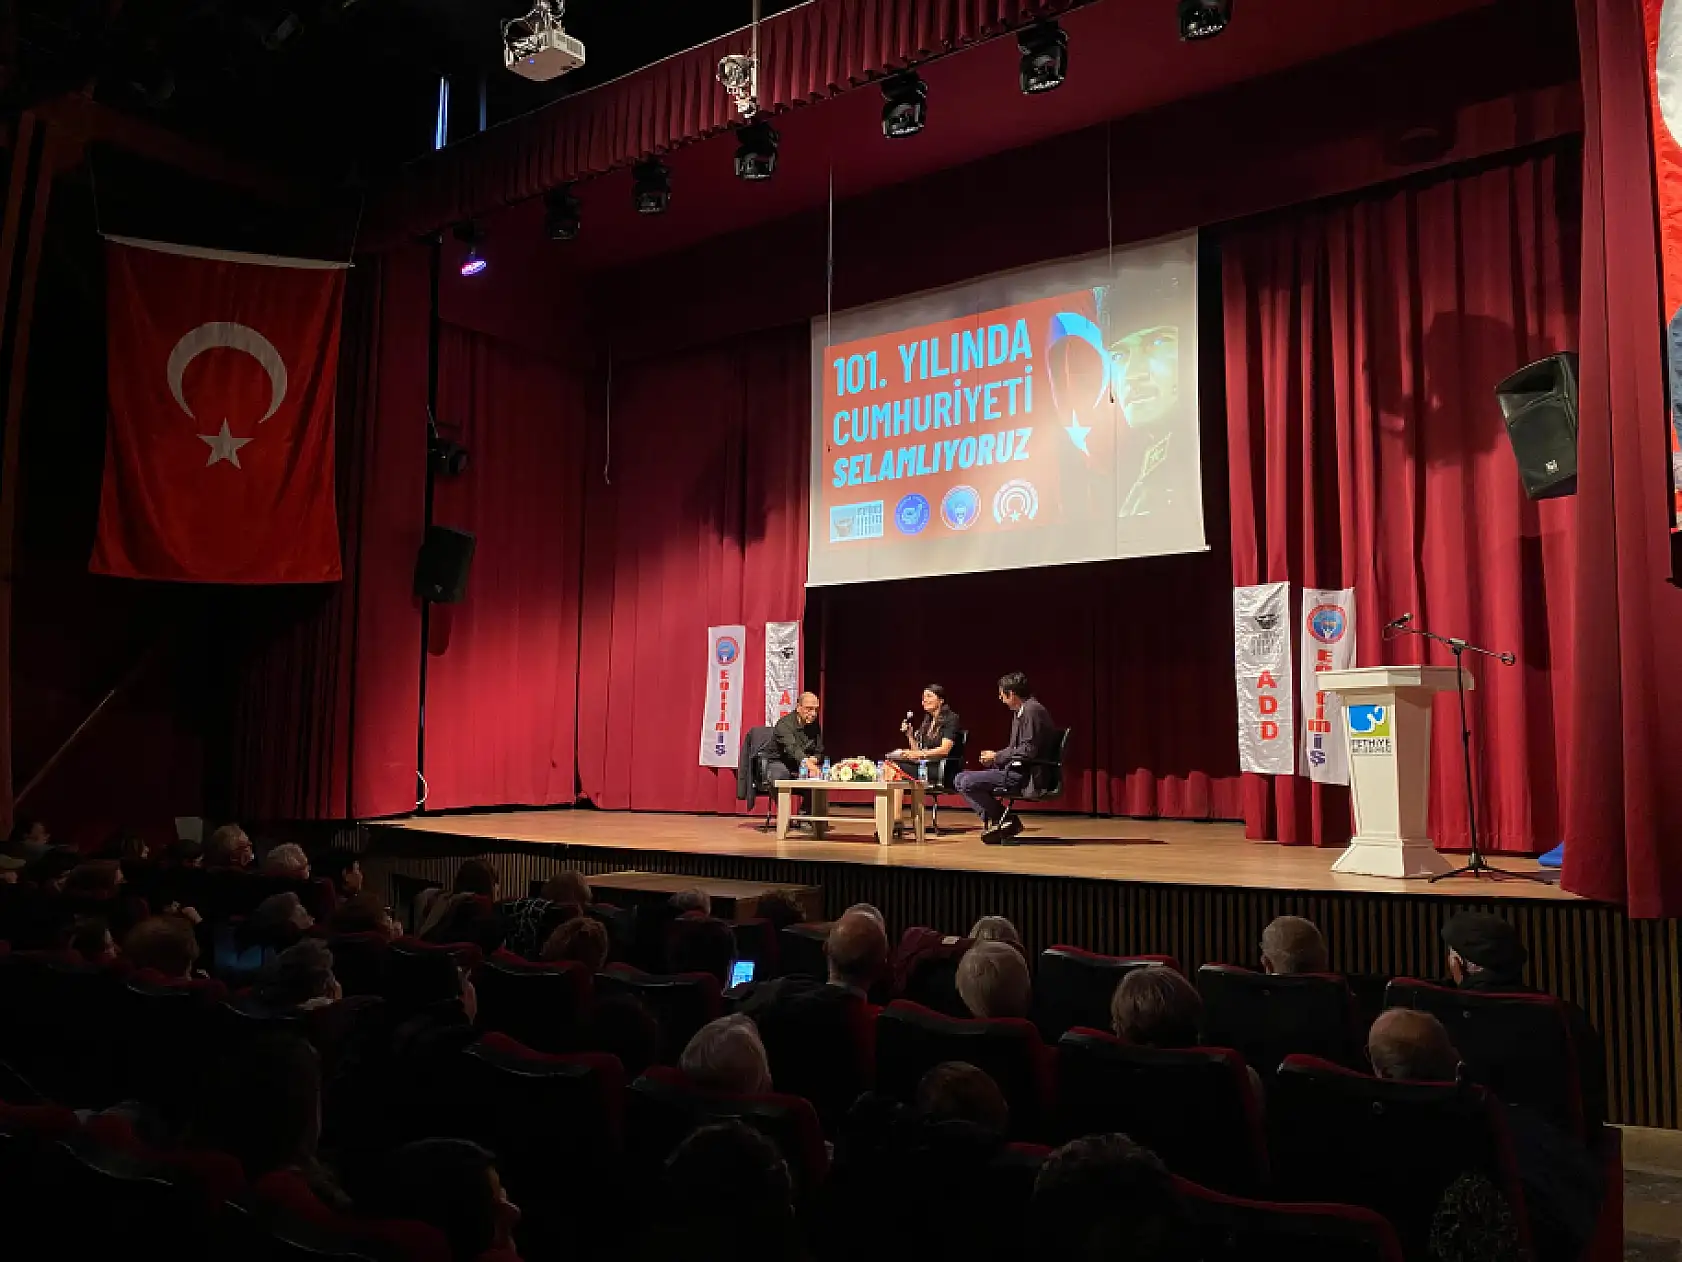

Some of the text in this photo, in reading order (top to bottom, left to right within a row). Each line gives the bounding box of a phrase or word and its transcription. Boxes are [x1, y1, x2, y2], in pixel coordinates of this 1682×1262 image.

[833, 318, 1032, 395] 101. YILINDA
[833, 366, 1032, 445] CUMHURİYETİ
[833, 428, 1032, 488] SELAMLIYORUZ
[1257, 670, 1279, 740] ADD
